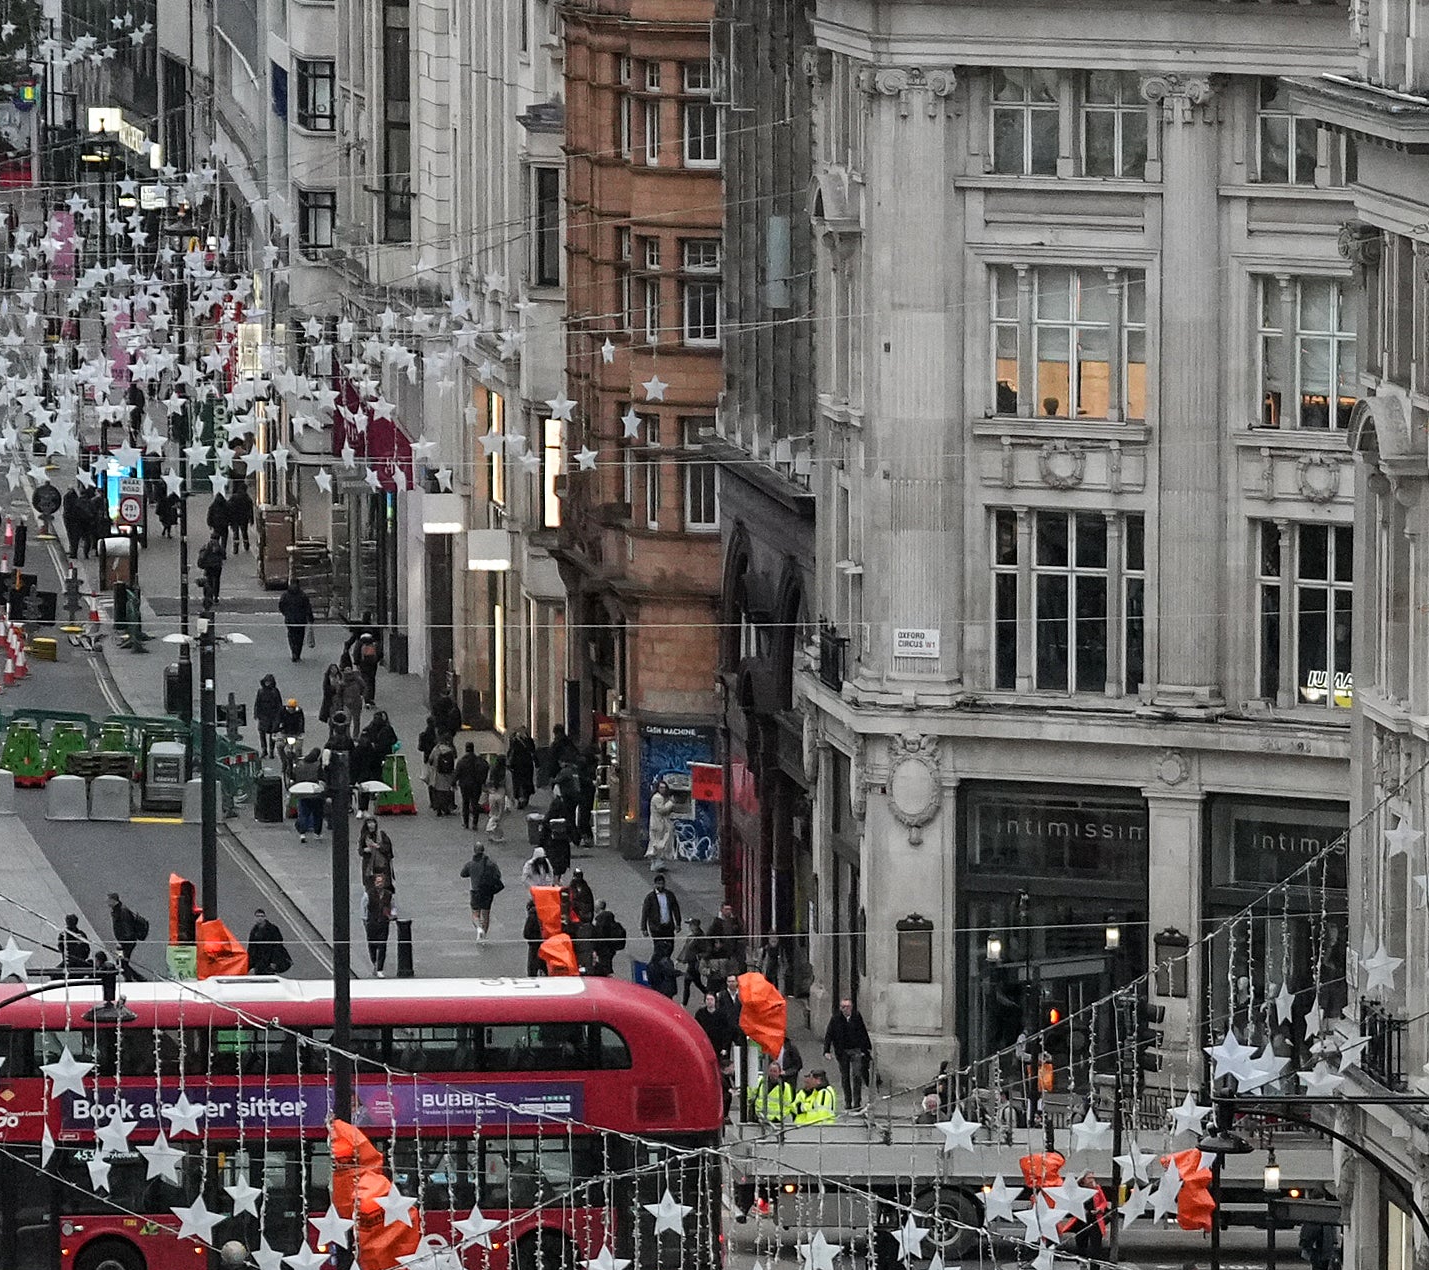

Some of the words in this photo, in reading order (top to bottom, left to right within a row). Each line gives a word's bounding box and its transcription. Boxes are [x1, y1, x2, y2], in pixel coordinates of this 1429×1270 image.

[897, 631, 925, 639] OXFORD
[897, 640, 923, 648] CIRCUS
[646, 726, 661, 734] CASH
[663, 728, 697, 736] MACHINE
[422, 1093, 497, 1107] BUBBLE
[73, 1099, 135, 1120] Book
[139, 1105, 155, 1119] a
[161, 1101, 232, 1119] ser
[237, 1096, 308, 1119] sitter
[74, 1150, 94, 1160] 453
